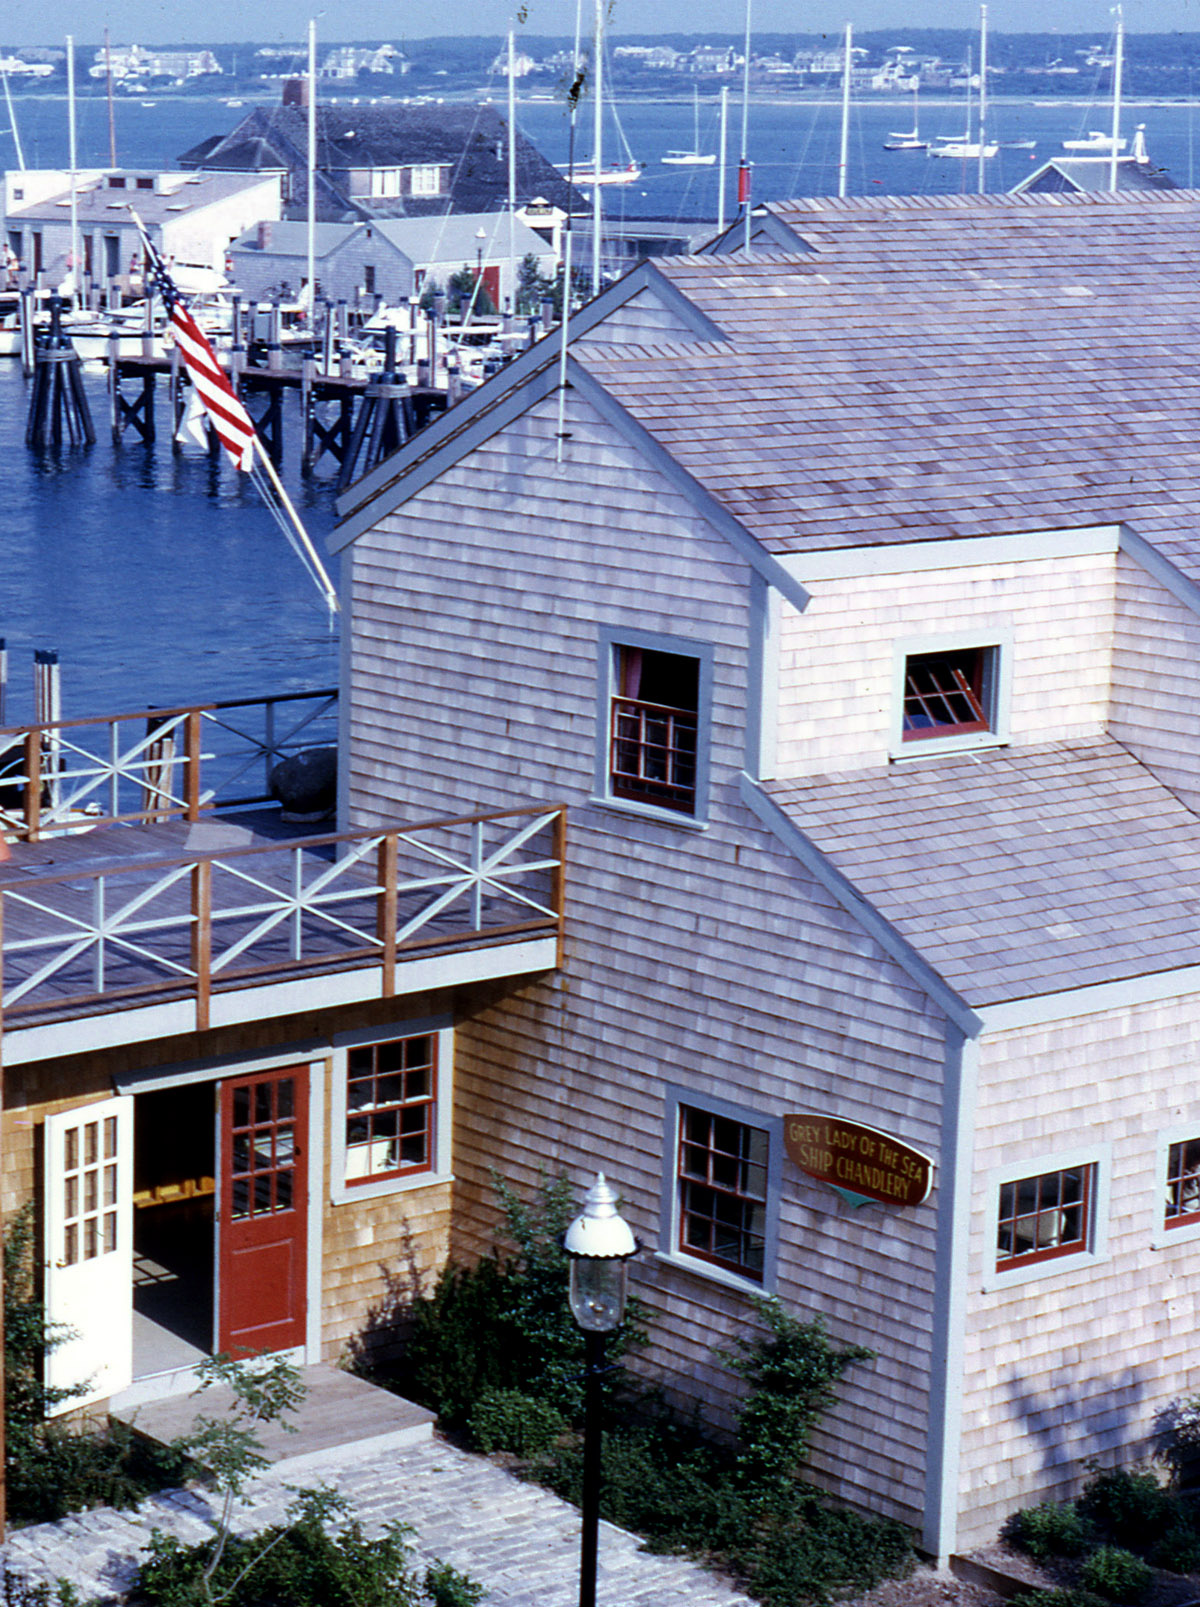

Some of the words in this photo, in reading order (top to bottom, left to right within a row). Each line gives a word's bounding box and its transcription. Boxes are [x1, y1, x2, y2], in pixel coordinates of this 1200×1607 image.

[789, 1122, 820, 1143] GREY
[825, 1126, 857, 1151] LADY
[859, 1136, 876, 1157] OF
[879, 1142, 899, 1169] THE
[901, 1156, 923, 1184] SEA
[799, 1144, 833, 1172] SHIP
[836, 1156, 911, 1200] CHANDLERY
